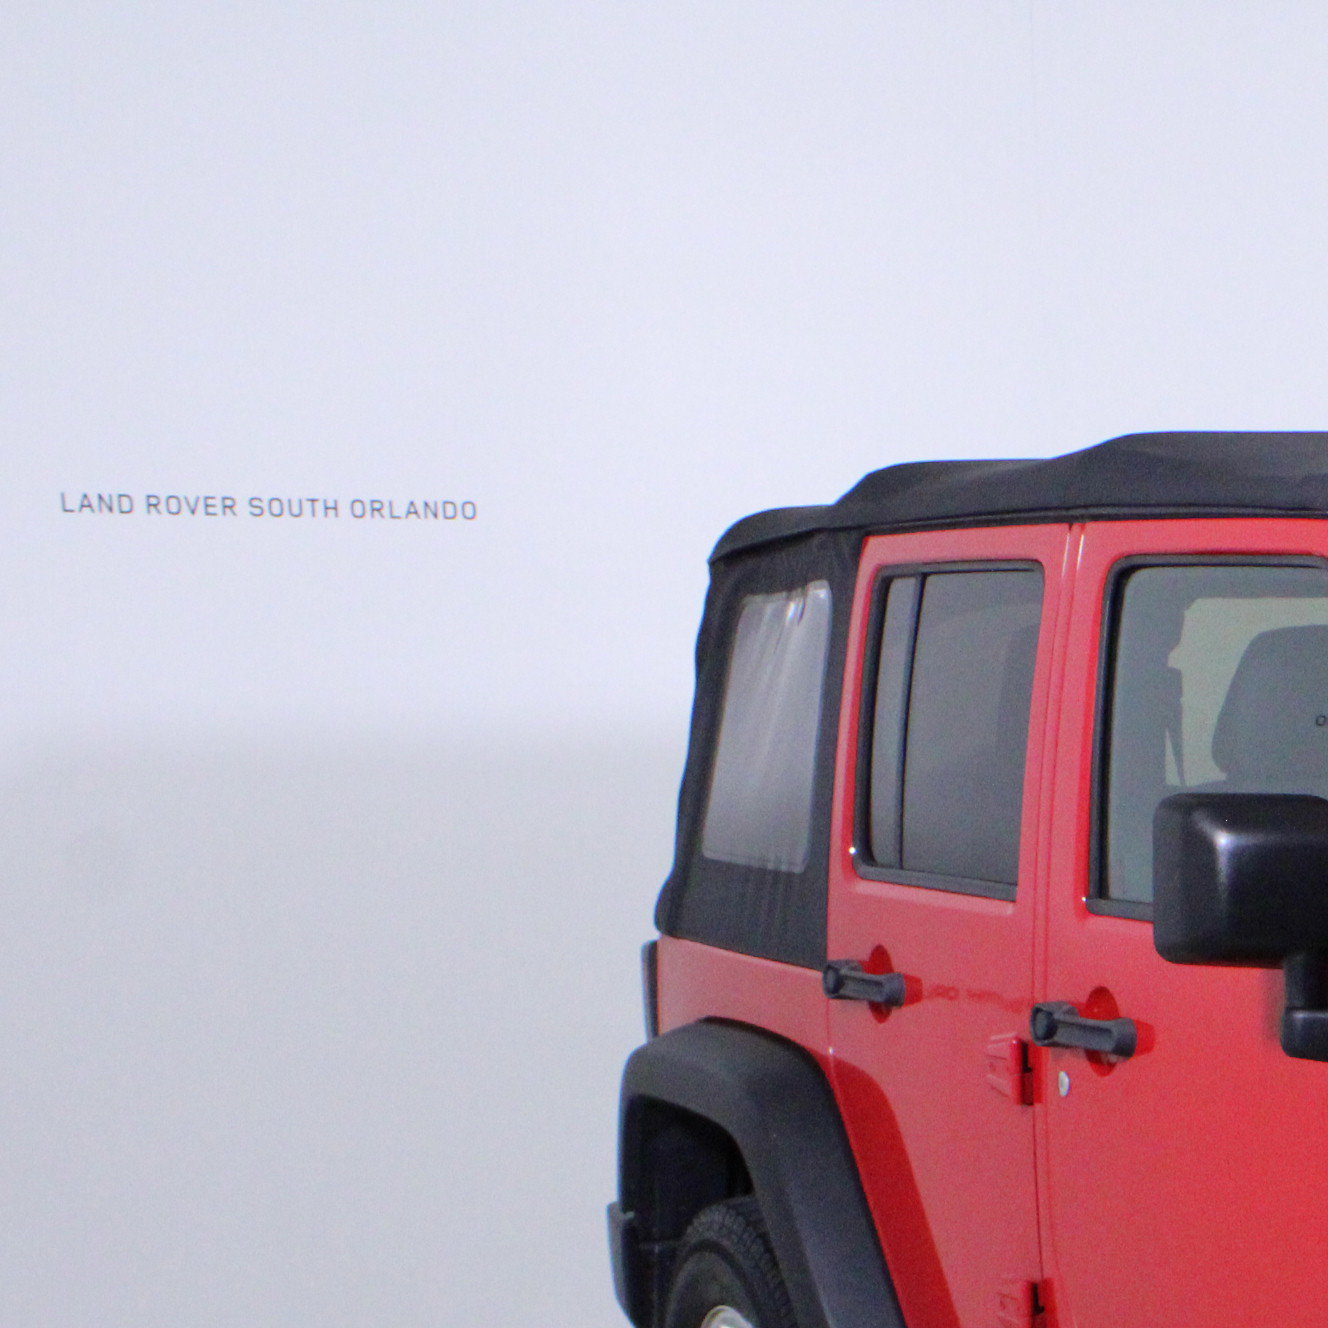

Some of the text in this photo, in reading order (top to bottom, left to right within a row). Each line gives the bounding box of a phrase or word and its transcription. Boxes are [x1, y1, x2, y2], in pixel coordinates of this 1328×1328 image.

[60, 491, 478, 521] LAND ROVER SOUTH ORLANDO
